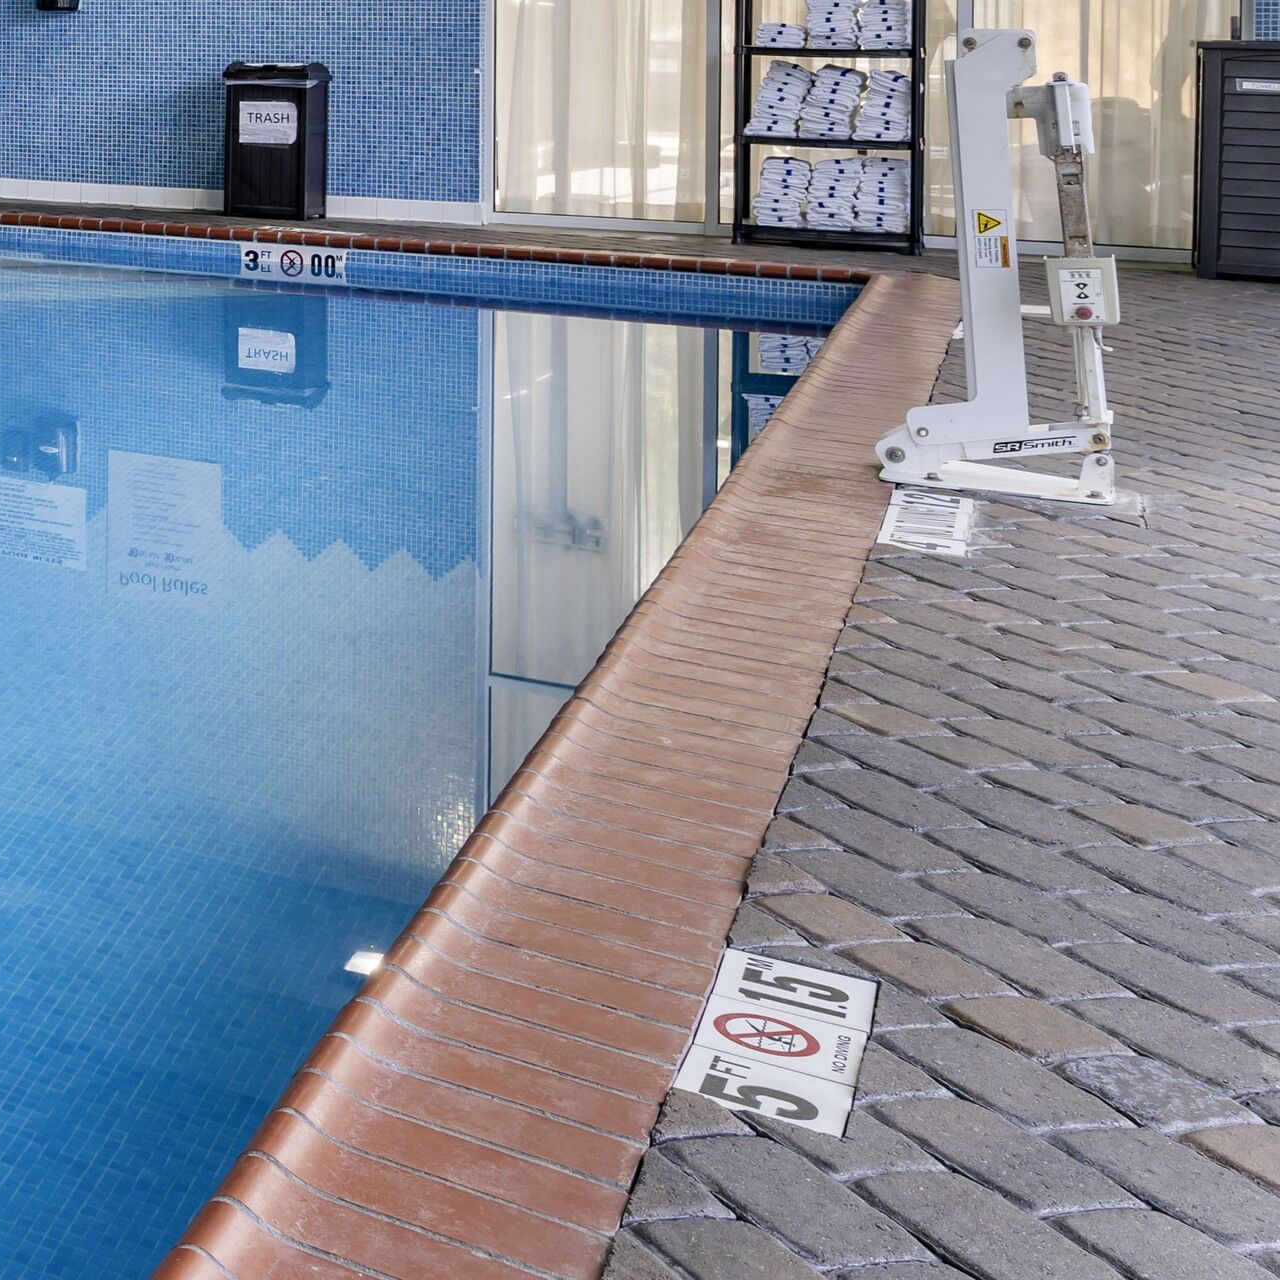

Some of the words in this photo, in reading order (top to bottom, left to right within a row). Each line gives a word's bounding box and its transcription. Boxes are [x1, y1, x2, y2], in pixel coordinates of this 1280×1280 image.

[247, 112, 290, 124] TRASH
[244, 250, 259, 271] 3
[260, 251, 272, 259] FT
[994, 442, 1020, 452] SR
[1023, 439, 1073, 449] Smith
[746, 957, 774, 971] M
[738, 967, 850, 1019] 1.5
[834, 1035, 851, 1062] DIVING
[709, 1055, 751, 1080] FT
[831, 1058, 846, 1074] NO
[699, 1072, 819, 1121] 5
